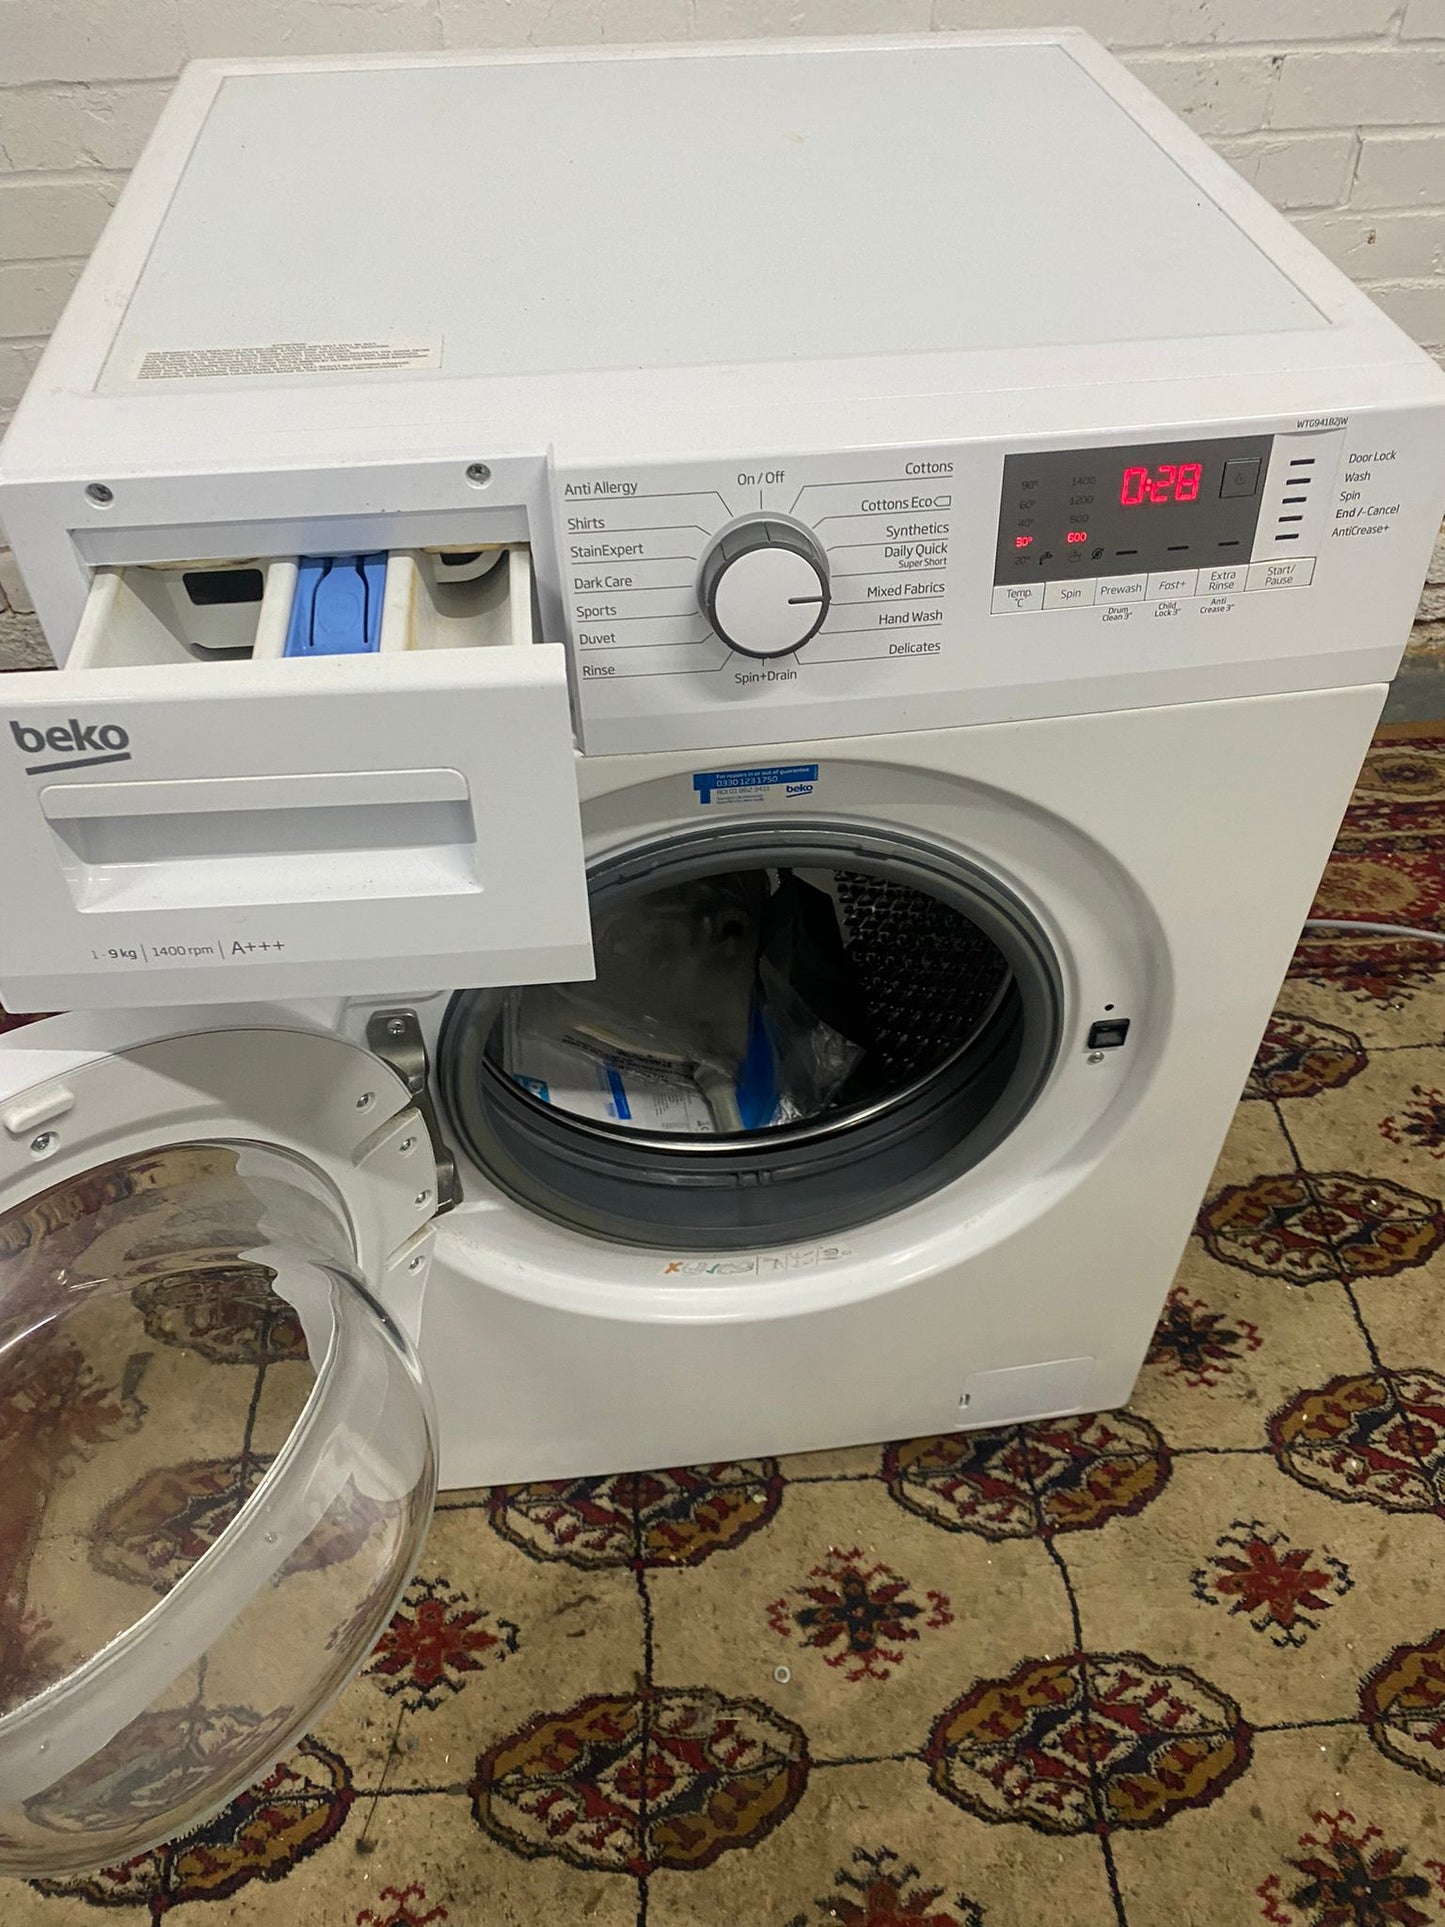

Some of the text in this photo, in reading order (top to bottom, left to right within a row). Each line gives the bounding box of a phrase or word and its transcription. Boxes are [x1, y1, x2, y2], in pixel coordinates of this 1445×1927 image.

[1349, 450, 1397, 464] Door Lock
[905, 462, 954, 475] Cottons
[737, 473, 755, 486] On
[765, 470, 785, 484] Off
[1072, 476, 1096, 487] 1400
[1344, 471, 1371, 483] Wash
[564, 481, 638, 496] Anti Allergy
[1121, 463, 1202, 505] 0:28
[1070, 496, 1094, 506] 1200
[1340, 490, 1361, 503] Spin
[861, 496, 933, 512] Cottons Eco
[1336, 508, 1356, 519] End
[568, 517, 605, 531] Shirts
[886, 522, 950, 538] Synthetics
[1331, 524, 1390, 538] AntiCrease+
[1067, 532, 1087, 543] 600
[570, 543, 643, 559] StainExpert
[884, 542, 948, 558] Daily Quick
[899, 557, 947, 569] Super Short
[1211, 570, 1236, 581] Extra
[1268, 564, 1295, 576] Start/
[574, 576, 632, 590] Dark Care
[1159, 580, 1186, 591] Fast+
[1209, 580, 1234, 590] Rinse
[1265, 576, 1293, 586] Pause
[867, 582, 945, 598] Mixed Fabrics
[1007, 588, 1032, 600] Temp.
[1061, 589, 1081, 600] Spin
[1101, 584, 1142, 596] Prewash
[1108, 607, 1128, 615] Drum
[1158, 602, 1176, 610] Child
[1200, 605, 1225, 614] Crease
[576, 606, 617, 619] Sports
[879, 610, 943, 625] Hand Wash
[1102, 613, 1123, 621] Clean
[1154, 609, 1171, 617] Lock
[580, 633, 616, 645] Duvet
[889, 641, 941, 655] Delicates
[583, 665, 615, 676] Rinse
[734, 670, 798, 685] Spin+Drain
[9, 718, 130, 753] beko
[786, 784, 813, 793] beko
[152, 945, 186, 958] 1400
[188, 945, 214, 957] rpm
[231, 940, 285, 956] A+++
